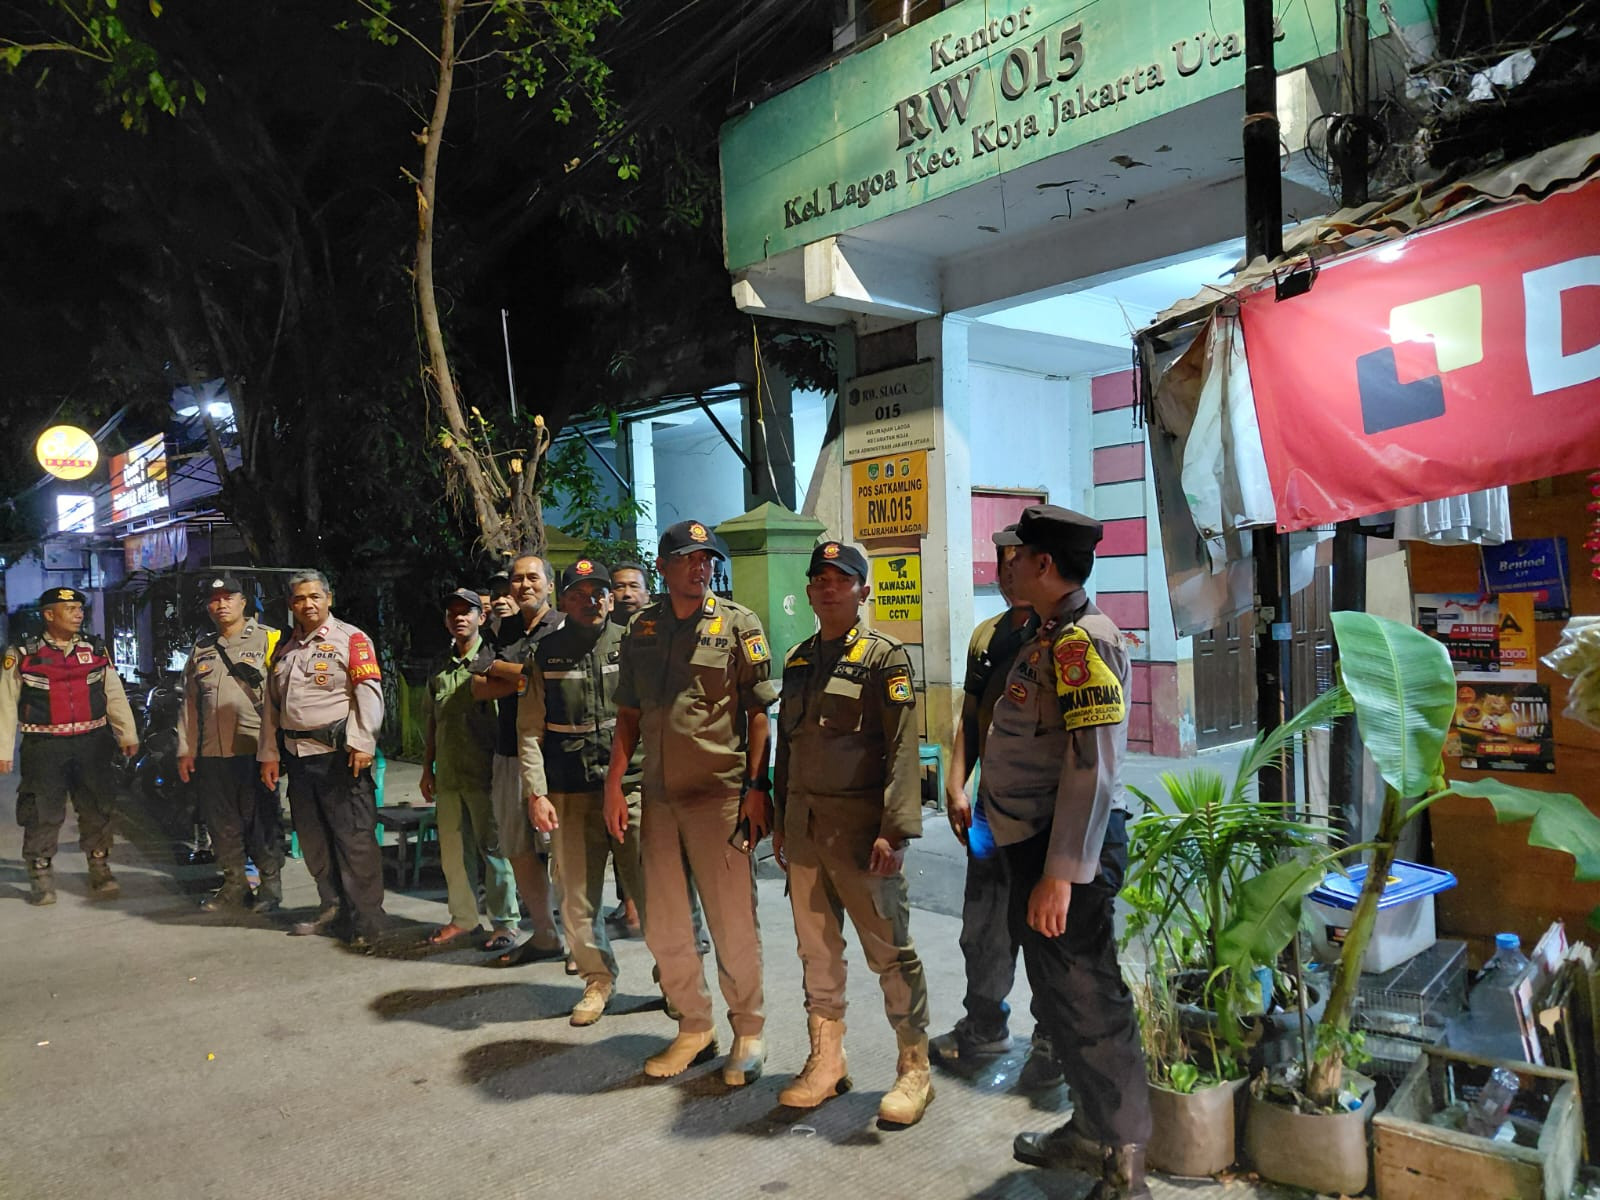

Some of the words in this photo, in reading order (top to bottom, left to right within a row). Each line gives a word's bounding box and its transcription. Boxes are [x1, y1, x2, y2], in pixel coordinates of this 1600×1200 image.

[930, 6, 1033, 74] Kantor
[896, 67, 981, 151] RW
[1000, 22, 1086, 101] 015
[828, 168, 898, 212] Lagoa
[905, 146, 960, 184] Kec.
[971, 113, 1040, 158] Koja
[1047, 63, 1166, 137] Jakarta
[880, 383, 908, 398] SIAGA
[875, 403, 901, 420] 015
[858, 486, 873, 498] POS
[874, 478, 922, 496] SATKAMLING
[868, 495, 913, 524] RW.015
[859, 526, 899, 537] KELURAHAN
[900, 523, 922, 533] LAGOA
[878, 580, 916, 592] KAWASAN
[877, 594, 920, 606] TERPANTAU
[889, 609, 909, 619] CCTV
[1498, 611, 1523, 633] A
[715, 637, 728, 648] PP
[1083, 714, 1114, 722] KOJA
[1511, 703, 1549, 724] SLIM
